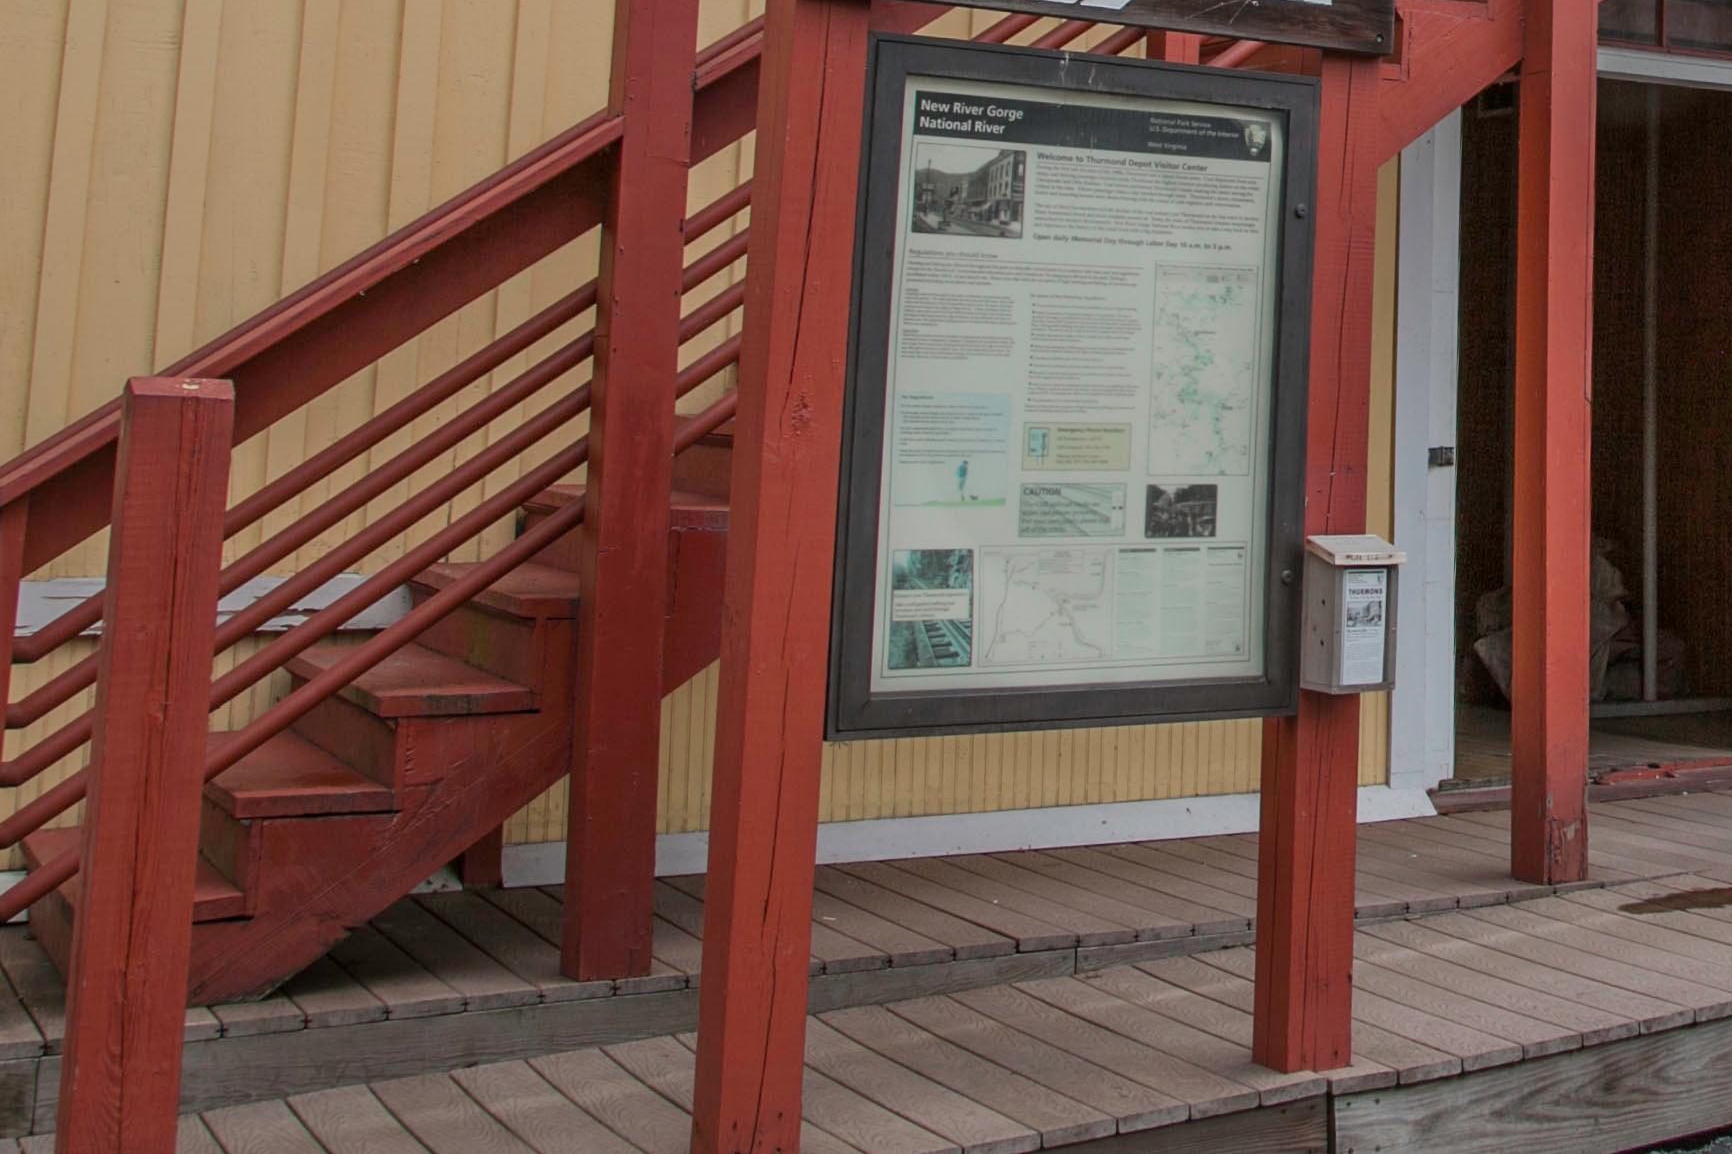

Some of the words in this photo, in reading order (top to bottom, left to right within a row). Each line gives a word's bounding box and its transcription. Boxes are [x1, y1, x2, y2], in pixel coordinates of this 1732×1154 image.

[920, 99, 950, 112] New
[952, 102, 983, 116] River
[986, 105, 1024, 122] Gorge
[919, 116, 971, 132] National
[974, 121, 1005, 135] River
[1036, 151, 1074, 162] Welcome
[1075, 155, 1085, 163] to
[1086, 155, 1127, 166] Thurmond
[1128, 158, 1152, 168] Depot
[1154, 160, 1180, 170] Visitor
[1181, 162, 1208, 172] Center
[1023, 487, 1062, 496] CAUTION
